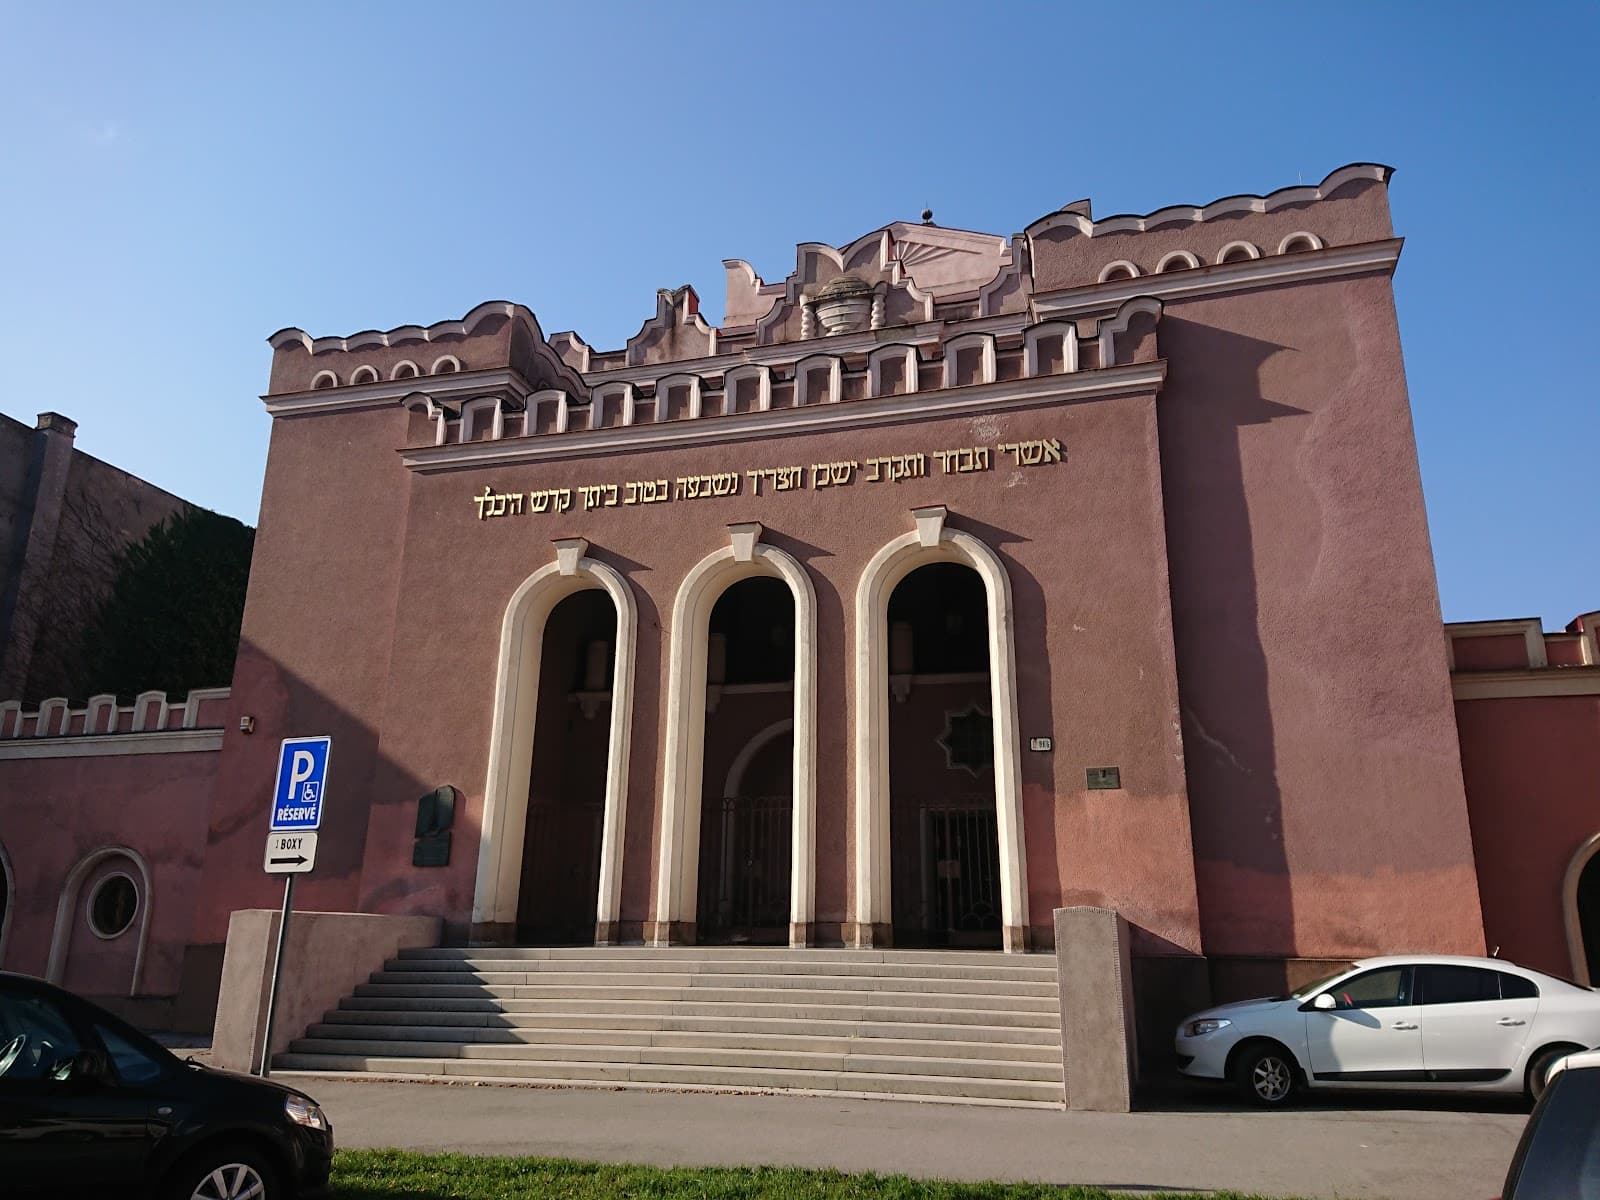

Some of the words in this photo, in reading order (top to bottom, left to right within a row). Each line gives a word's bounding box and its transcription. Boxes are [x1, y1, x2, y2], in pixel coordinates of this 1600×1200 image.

[933, 446, 989, 473] תבחר
[997, 438, 1061, 465] אשרי
[747, 465, 802, 495] חצריך
[811, 460, 858, 488] ישכן
[865, 452, 925, 481] ותקרב
[578, 481, 618, 510] ביתך
[624, 479, 668, 504] בטוב
[676, 472, 739, 499] נשבעה
[474, 486, 523, 520] היכלך
[530, 488, 571, 513] קדש
[287, 750, 315, 800] P
[276, 803, 316, 821] RÉSERVÉ
[280, 837, 303, 850] BOXY
